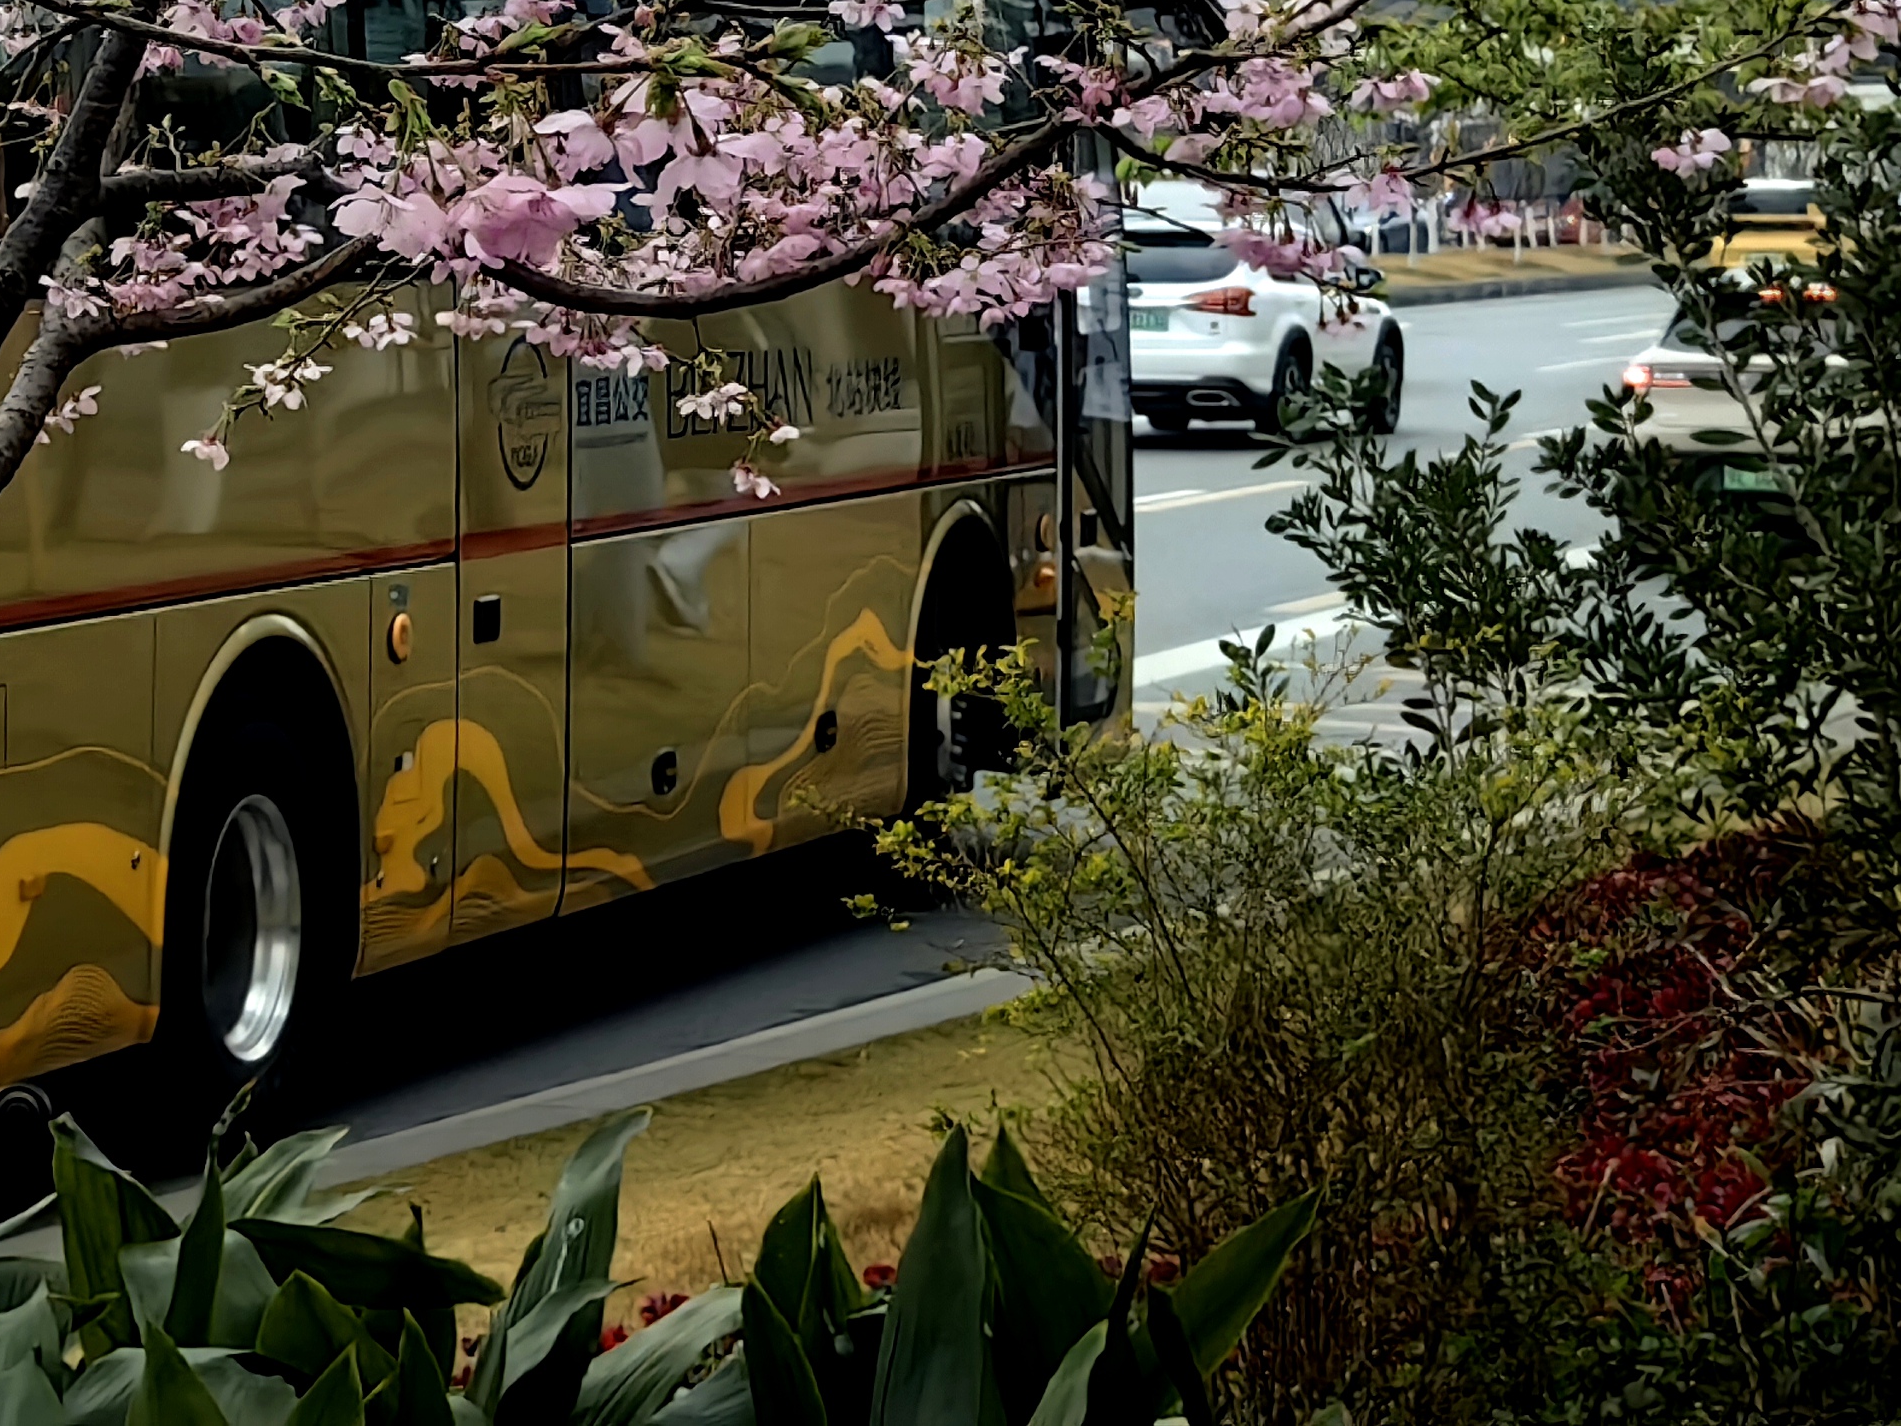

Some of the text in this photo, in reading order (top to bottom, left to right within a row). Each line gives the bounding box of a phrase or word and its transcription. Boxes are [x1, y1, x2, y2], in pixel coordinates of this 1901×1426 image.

[575, 375, 648, 426] 宜昌公交
[666, 347, 814, 439] BEZHAN
